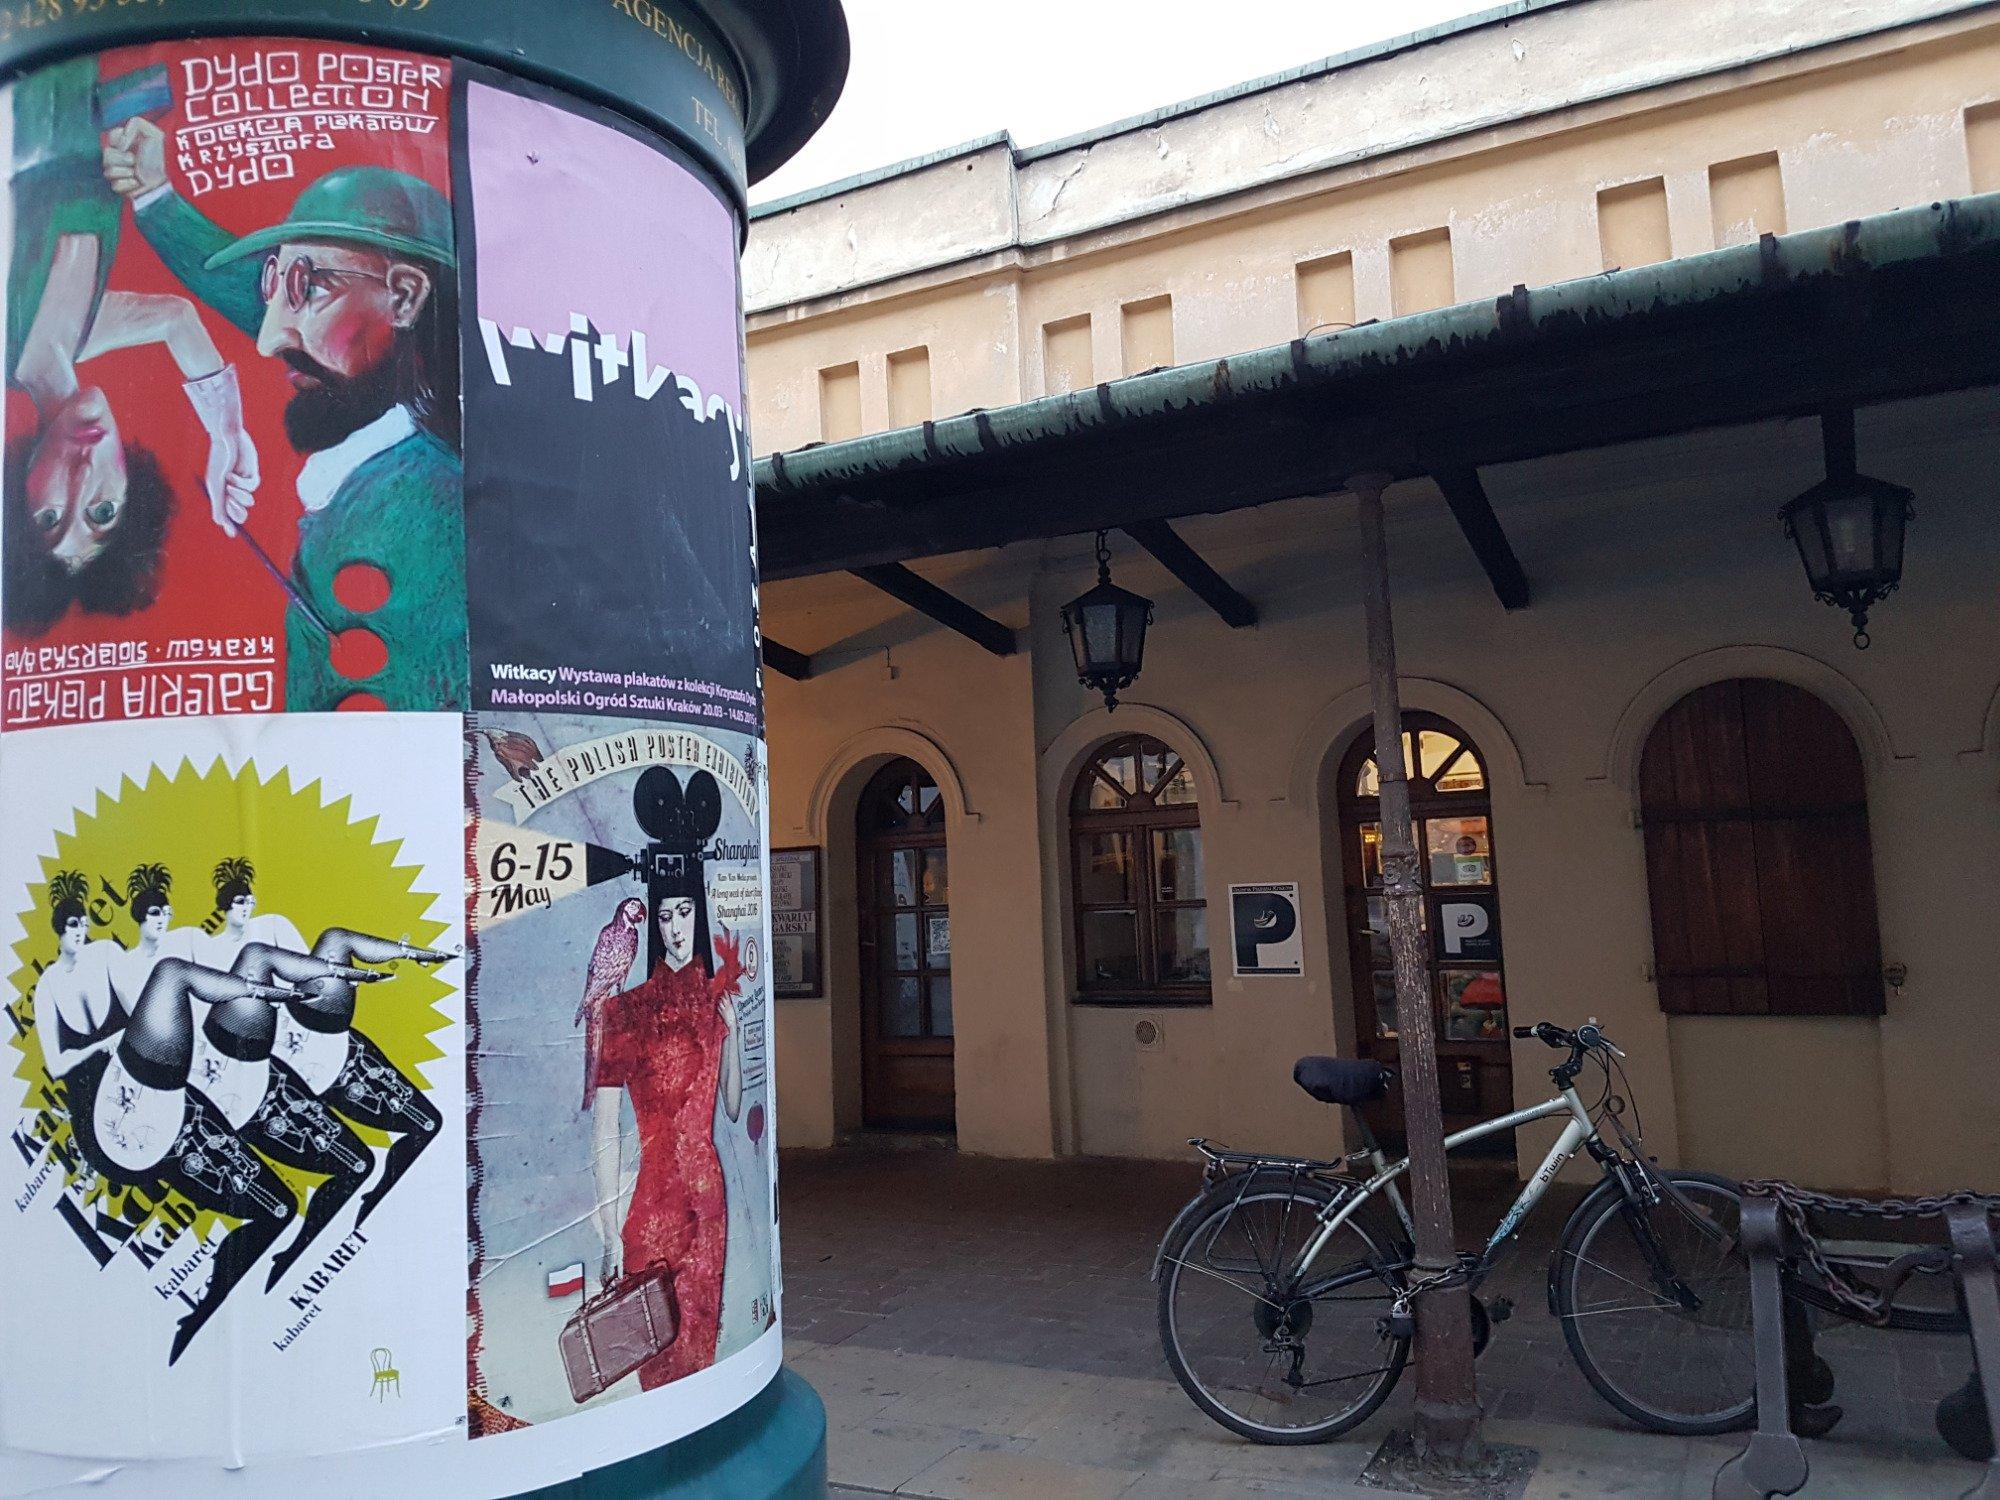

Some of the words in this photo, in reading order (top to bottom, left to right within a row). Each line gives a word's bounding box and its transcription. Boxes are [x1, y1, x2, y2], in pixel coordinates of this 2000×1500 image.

[490, 663, 557, 684] Witkacy
[558, 666, 622, 687] Wystawa
[624, 670, 676, 690] plakatów
[677, 679, 683, 690] z
[684, 677, 715, 699] kolekcji
[490, 688, 581, 709] Małopolski
[583, 692, 627, 710] Ogród
[629, 694, 665, 711] Sztuki
[667, 697, 701, 715] Kraków
[702, 703, 724, 718] 20.03
[514, 767, 564, 808] THE
[567, 736, 638, 782] POLISH
[647, 735, 700, 762] POSTER
[490, 842, 574, 882] 6-15
[715, 837, 760, 866] Shanghai
[490, 883, 552, 918] May
[154, 1236, 218, 1301] kabaret
[289, 1229, 370, 1311] KABARET
[272, 1303, 322, 1352] kabaret
